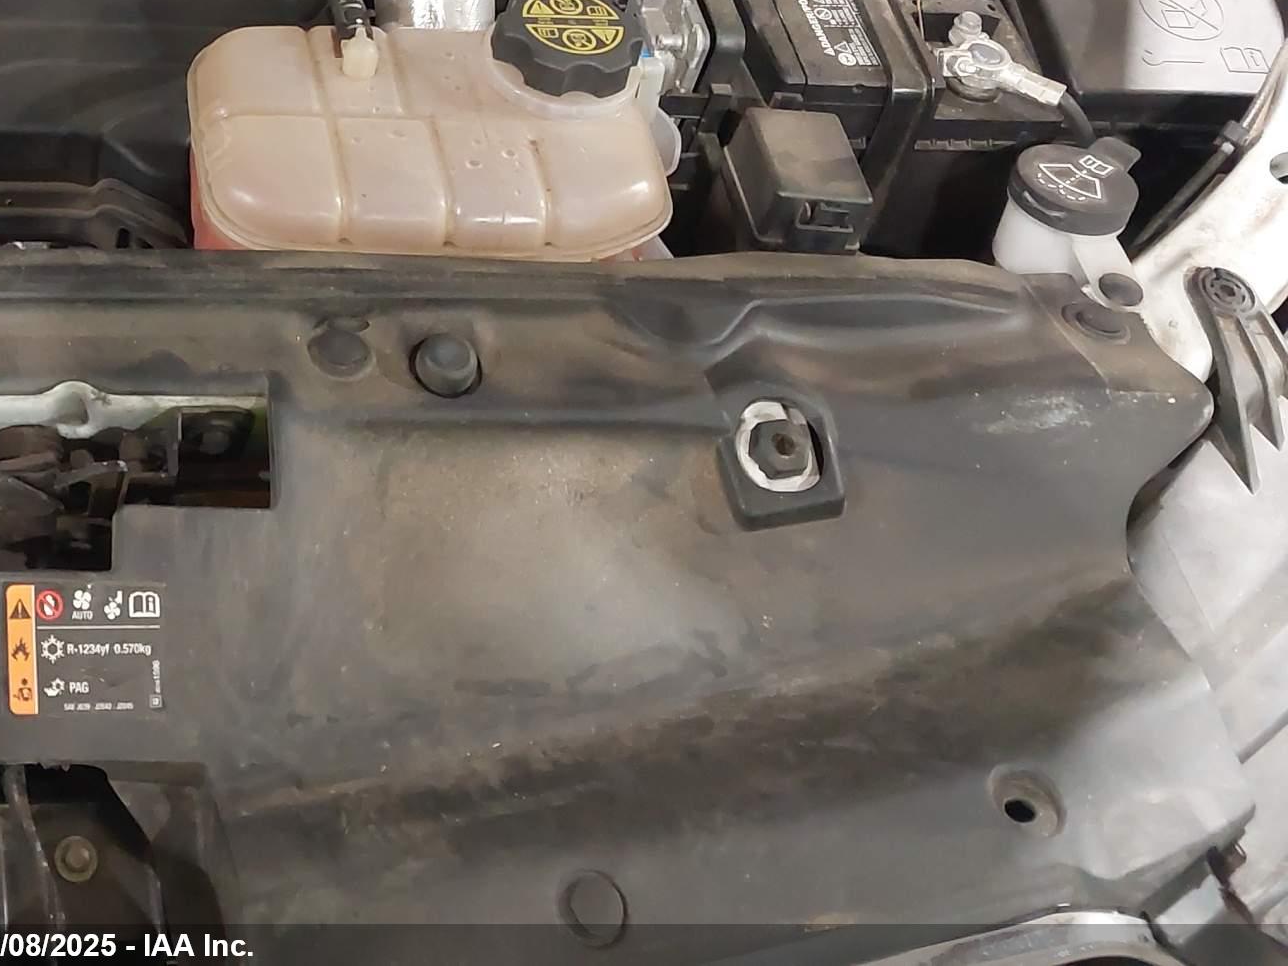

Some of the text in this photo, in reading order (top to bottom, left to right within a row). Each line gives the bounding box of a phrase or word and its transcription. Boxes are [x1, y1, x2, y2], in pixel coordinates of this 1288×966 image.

[72, 610, 93, 620] AUTO
[67, 643, 152, 657] R-1234yf 0.570kg
[69, 682, 89, 694] PAG
